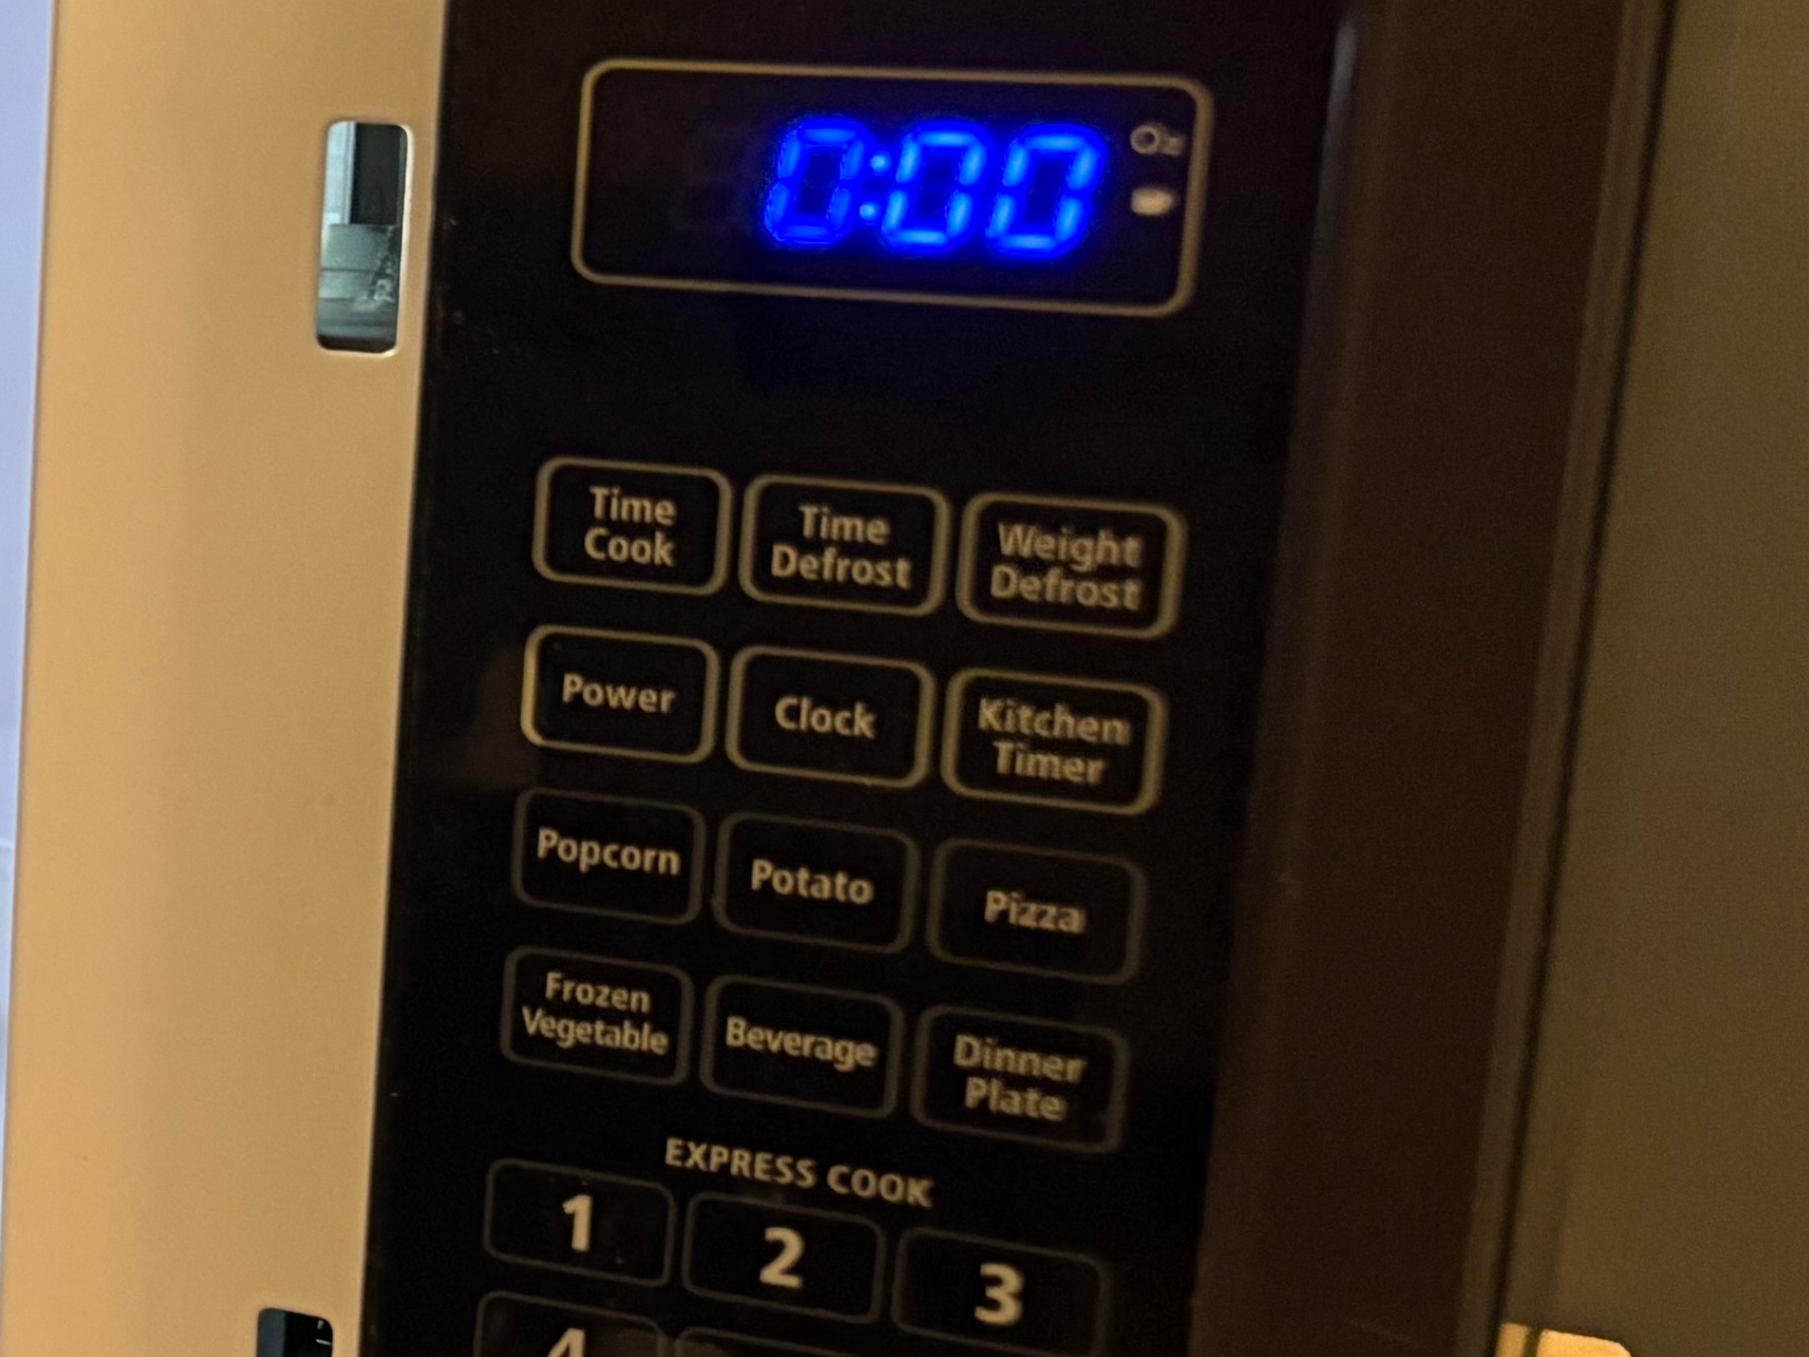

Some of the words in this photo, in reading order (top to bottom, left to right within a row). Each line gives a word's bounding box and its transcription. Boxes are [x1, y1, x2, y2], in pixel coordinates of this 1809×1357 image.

[766, 117, 1106, 253] 0:00
[589, 486, 677, 528] Time
[799, 504, 891, 546] Time
[584, 527, 675, 568] Cook
[771, 544, 912, 591] Defrost
[999, 522, 1142, 571] Weight
[991, 564, 1141, 611] Defrost
[562, 672, 675, 716] Power
[774, 696, 875, 739] Clock
[978, 699, 1131, 747] Kitchen
[994, 741, 1103, 786] Timer
[537, 828, 681, 878] Popcorn
[751, 860, 874, 905] Potato
[985, 892, 1086, 936] Pizza
[545, 972, 650, 1014] Frozen
[523, 1008, 669, 1056] Vegetable
[726, 1017, 877, 1069] Beverage
[954, 1035, 1087, 1085] Dinner
[966, 1078, 1067, 1122] Plate
[665, 1138, 815, 1188] EXPRESS
[828, 1163, 934, 1208] COOK
[563, 1196, 591, 1252] 1
[760, 1230, 803, 1289] 2
[974, 1264, 1024, 1325] 3
